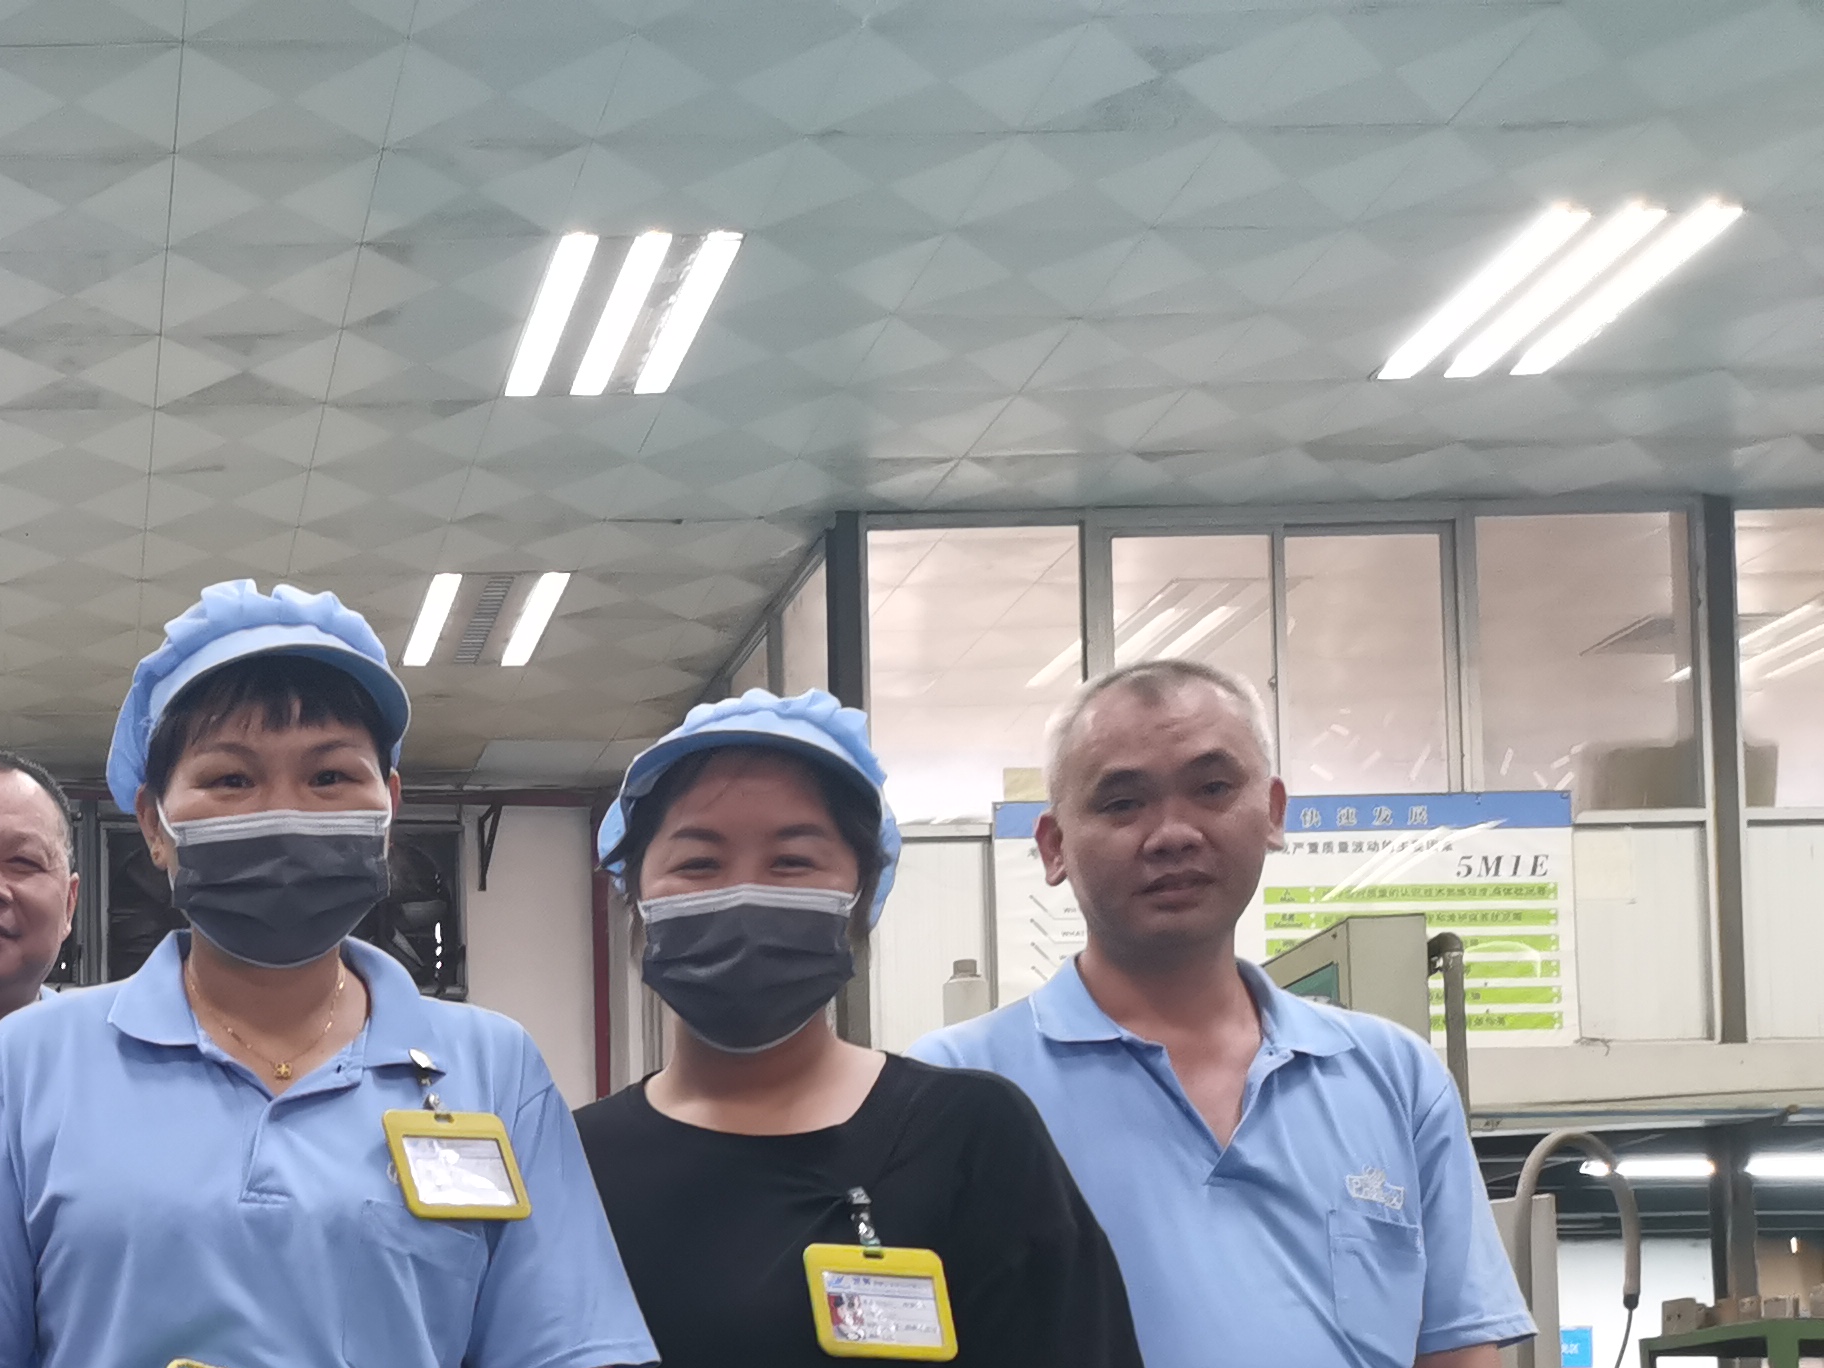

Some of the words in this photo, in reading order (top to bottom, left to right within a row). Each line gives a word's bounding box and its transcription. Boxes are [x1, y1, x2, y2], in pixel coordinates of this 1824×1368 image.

[1299, 804, 1430, 829] 快速发展
[1455, 853, 1551, 879] 5M1E
